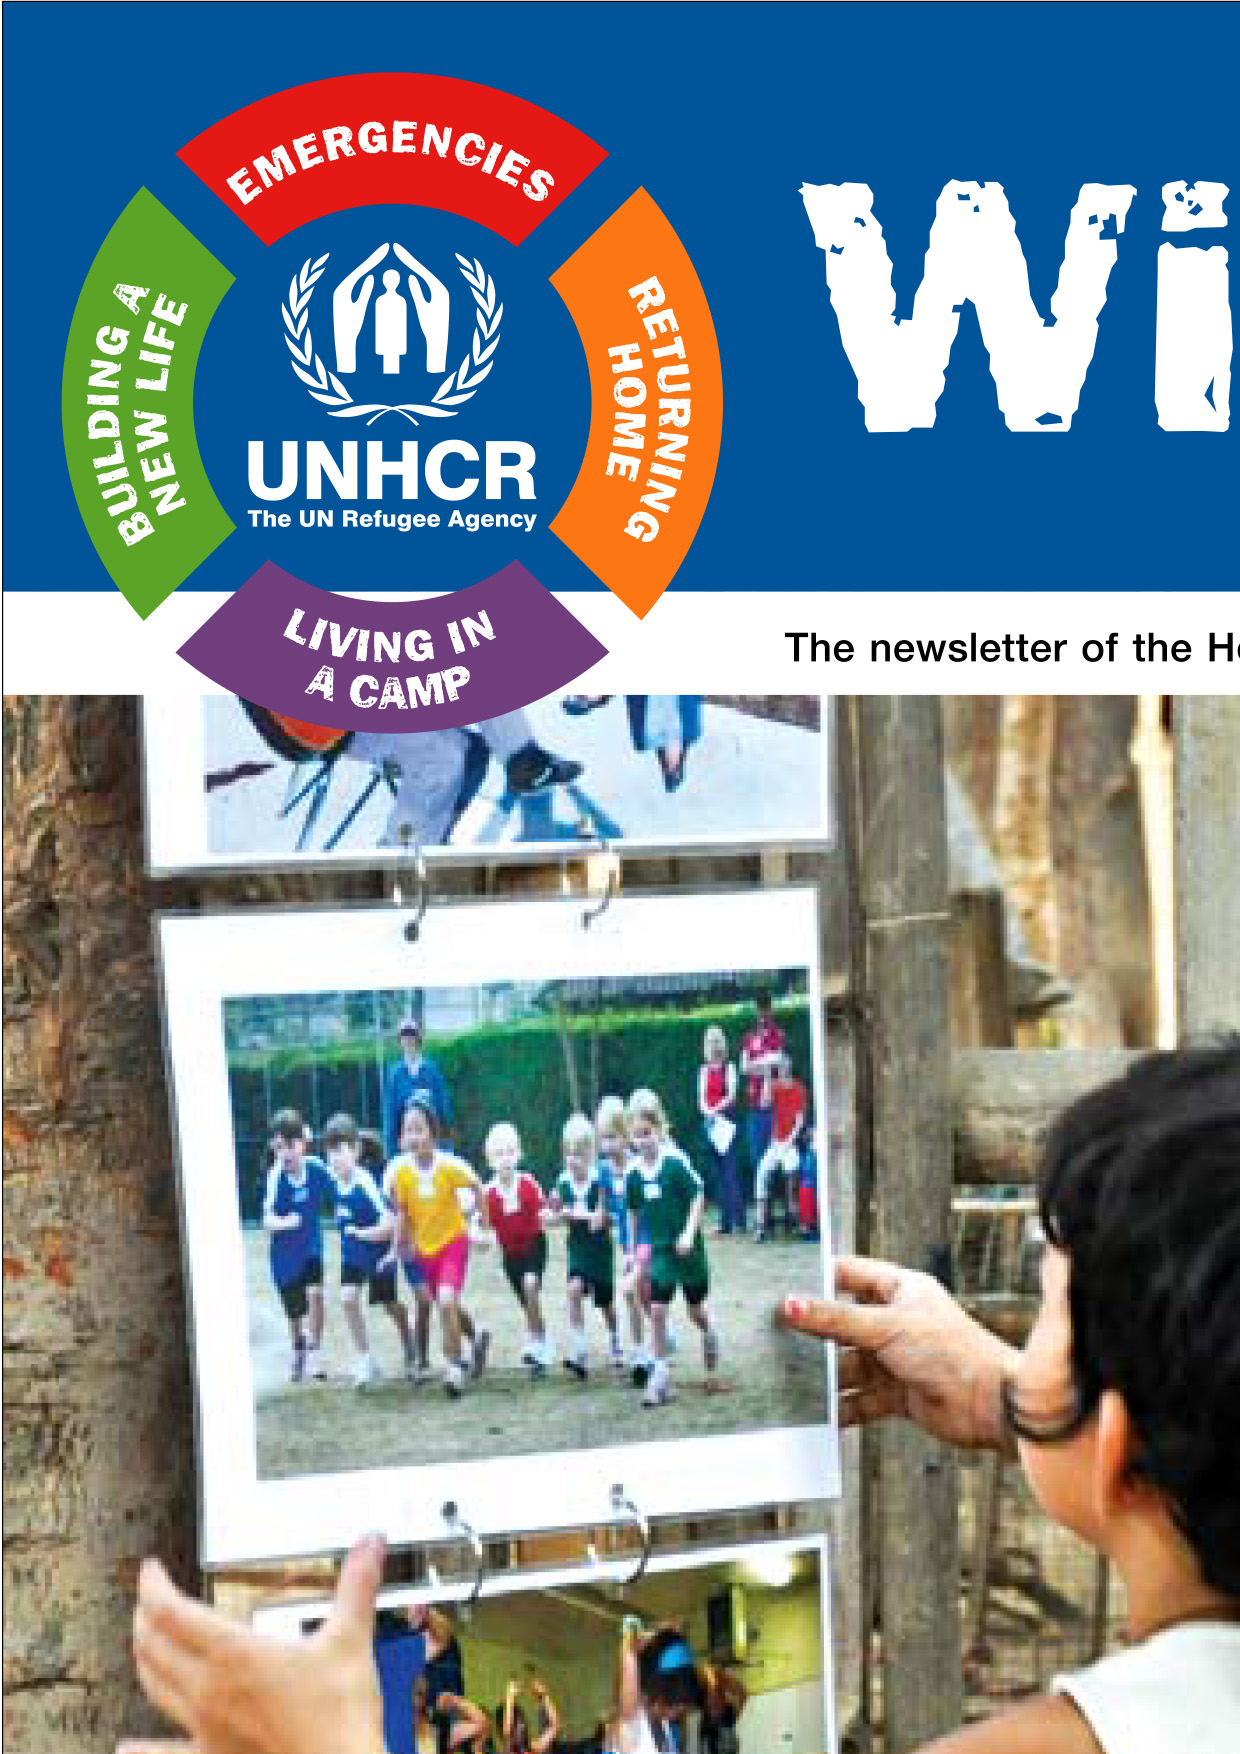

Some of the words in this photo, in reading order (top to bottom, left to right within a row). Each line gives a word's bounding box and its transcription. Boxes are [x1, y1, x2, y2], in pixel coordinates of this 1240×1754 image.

[227, 121, 554, 205] EMERGENCIES
[113, 284, 150, 315] A
[136, 293, 188, 391] LIFE
[87, 326, 156, 546] BUILDING
[606, 343, 646, 481] HOME
[624, 276, 691, 542] RETURNING
[134, 410, 186, 515] NEW
[249, 440, 536, 501] UNHCR
[248, 510, 291, 527] The
[300, 510, 333, 527] UN
[343, 510, 440, 531] Refugee
[448, 510, 536, 531] Agency
[284, 608, 434, 663] LIVING
[447, 610, 496, 654] IN
[785, 633, 854, 662] The
[872, 633, 1067, 662] newsletter
[1083, 633, 1118, 662] of
[1133, 633, 1191, 662] the
[305, 665, 333, 701] A
[350, 666, 470, 709] CAMP
